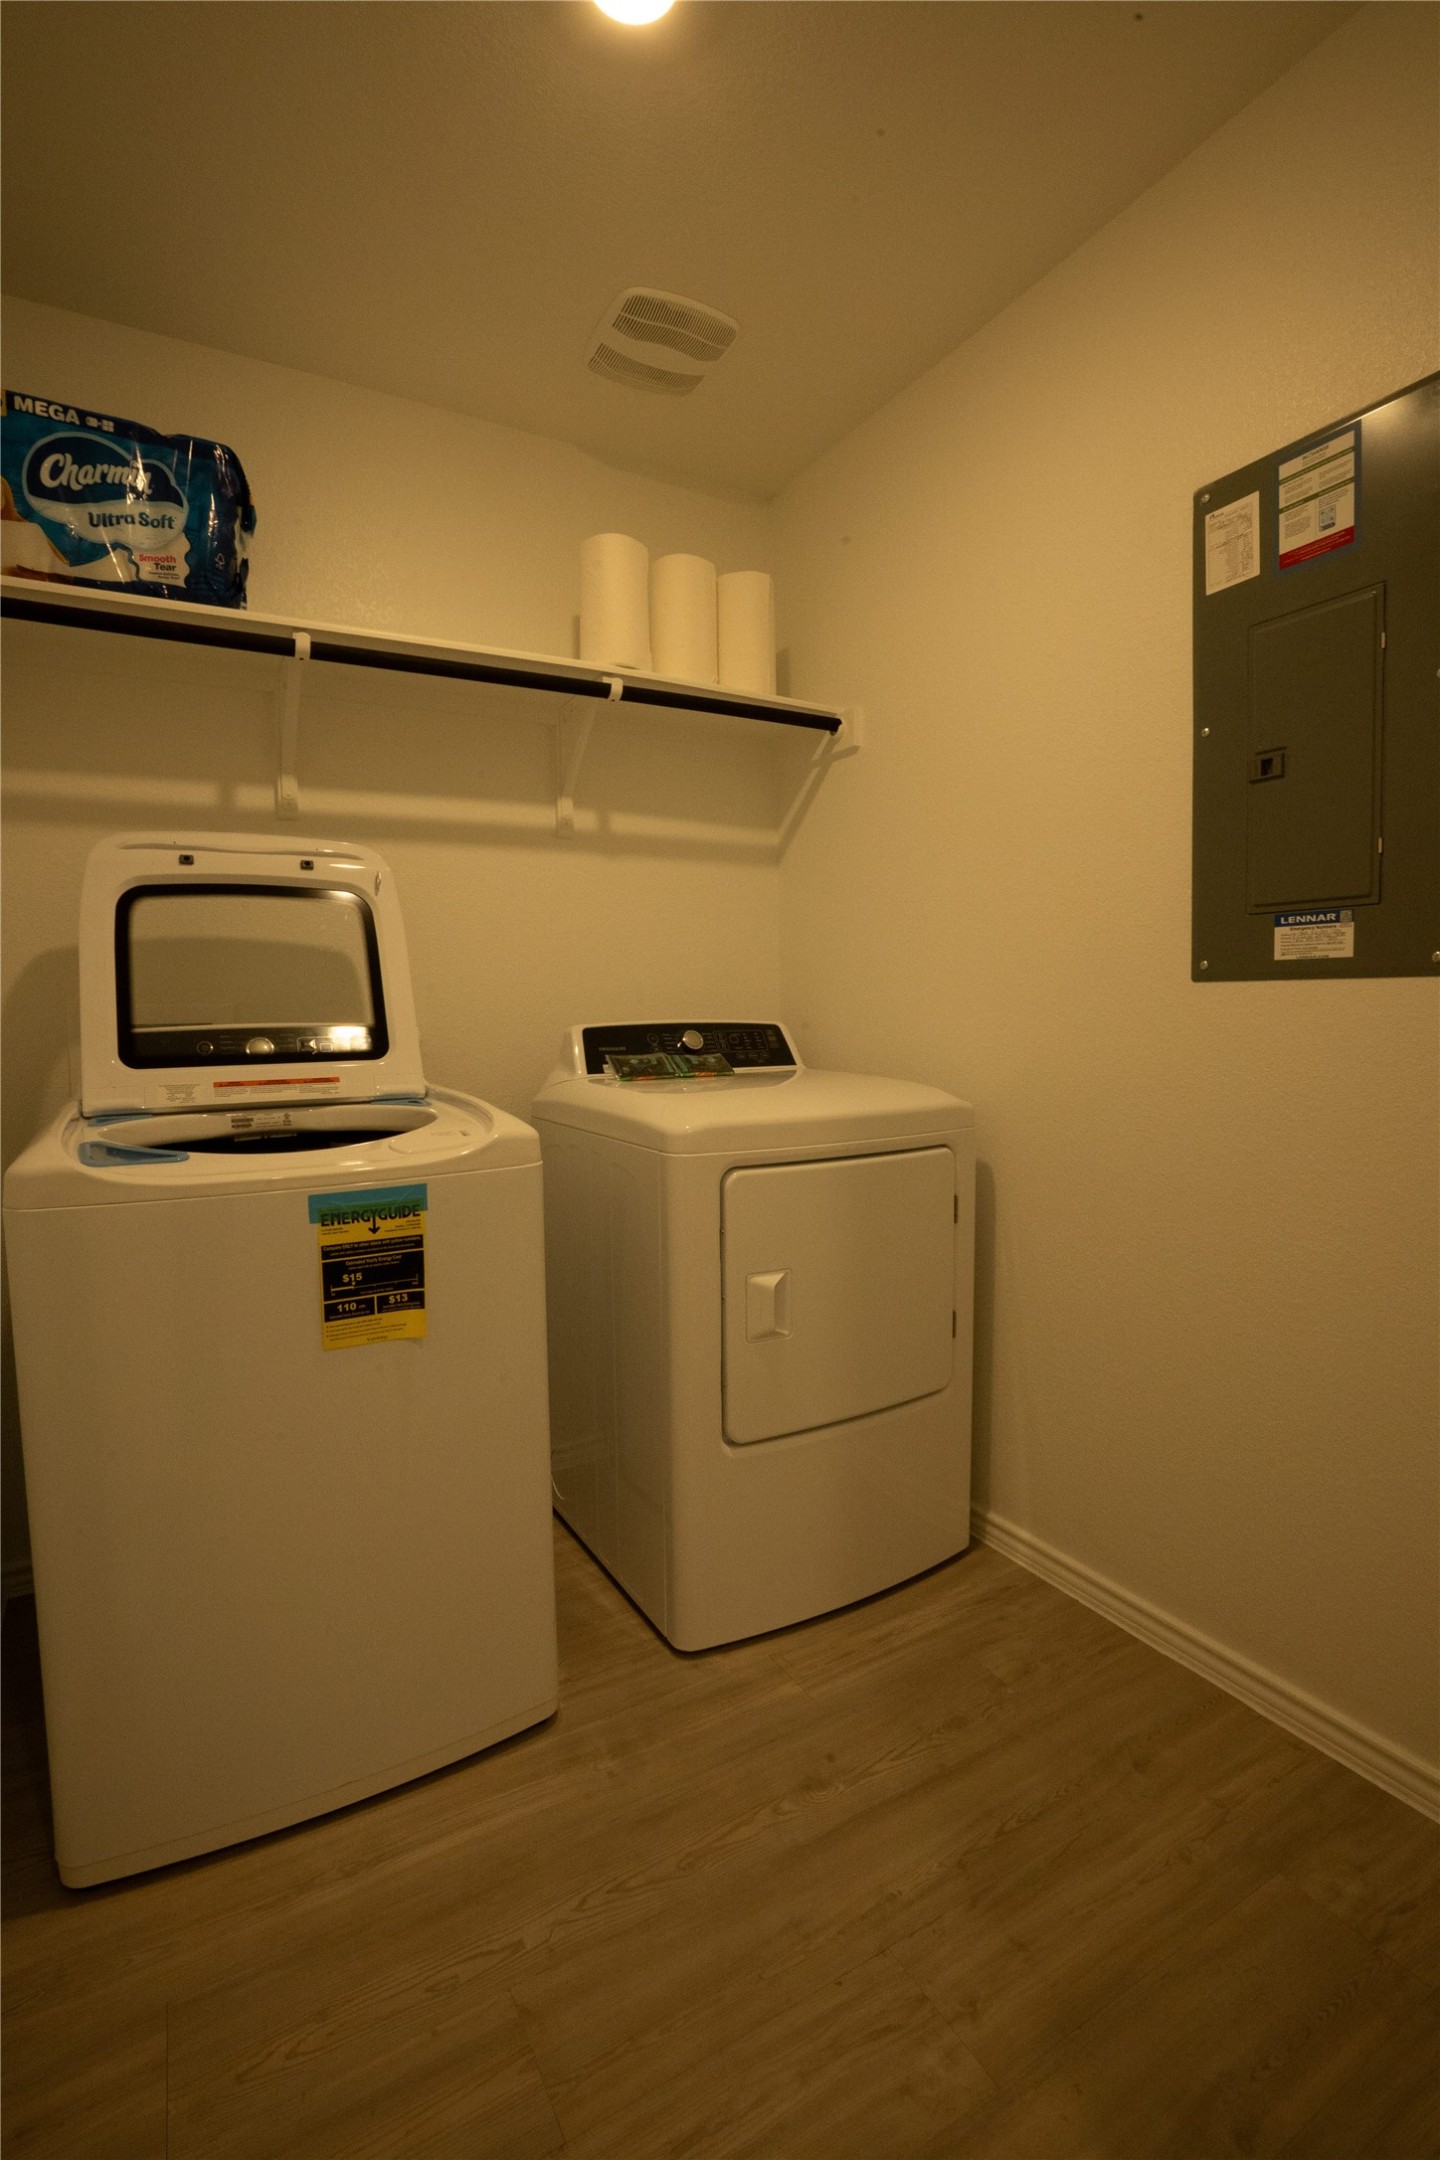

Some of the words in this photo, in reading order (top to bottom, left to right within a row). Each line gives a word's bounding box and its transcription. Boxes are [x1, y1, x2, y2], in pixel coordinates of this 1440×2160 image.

[13, 395, 80, 425] MEGA
[40, 453, 153, 495] Charmin
[88, 511, 135, 528] Ultra
[138, 512, 175, 530] Soft
[139, 553, 176, 564] Smooth
[154, 562, 177, 572] Tear
[1281, 913, 1337, 924] LENNAR
[321, 1204, 421, 1227] ENERGYGUIDE
[342, 1273, 363, 1282] $15
[389, 1294, 409, 1304] $13
[337, 1303, 357, 1312] 110
